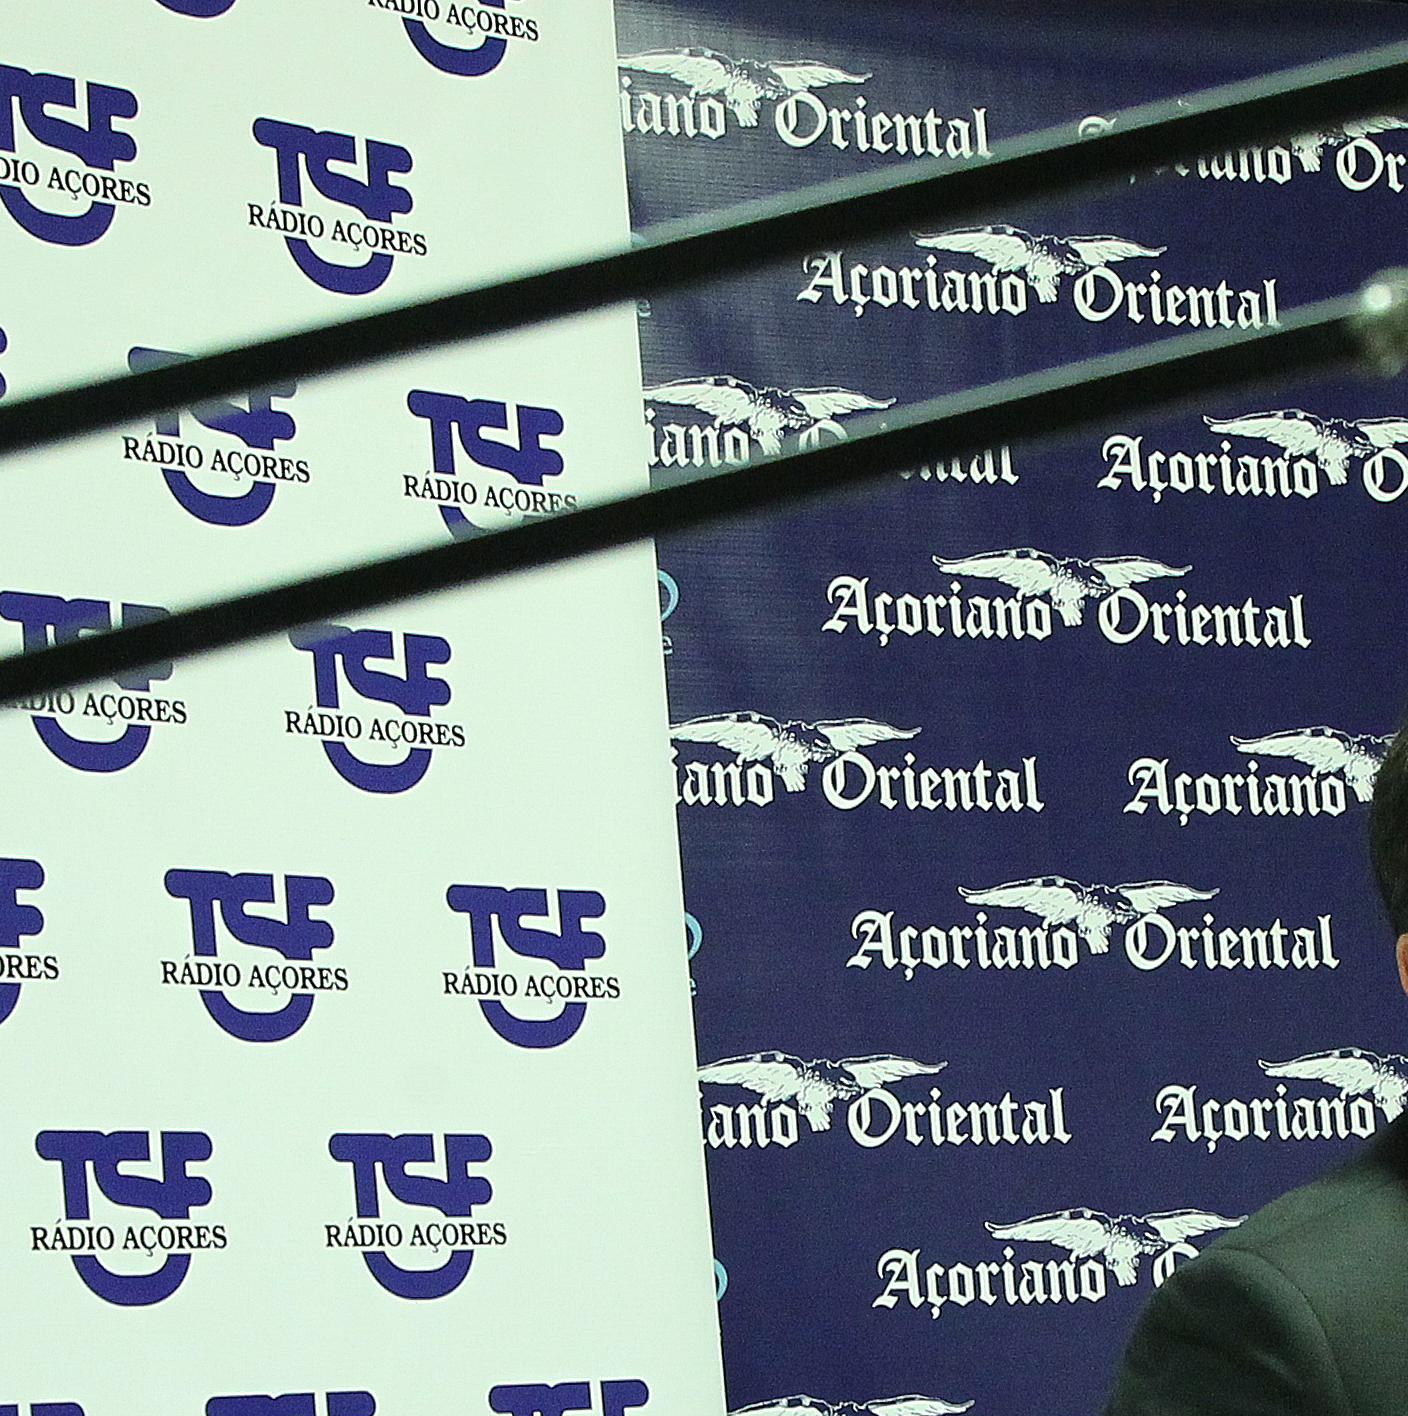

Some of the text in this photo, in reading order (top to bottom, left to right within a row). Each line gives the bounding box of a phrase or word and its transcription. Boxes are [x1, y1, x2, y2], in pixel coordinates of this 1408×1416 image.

[445, 3, 539, 42] AÇORES
[775, 90, 995, 159] Oriental
[47, 167, 152, 207] AÇORES
[247, 202, 428, 257] RÁDIO AÇORES
[796, 250, 1283, 330] Açoriano Oriental
[122, 432, 311, 484] RÁDIO AÇORES
[1096, 434, 1318, 504] Açoriano
[402, 471, 577, 517] RÁDIO AÇORES
[820, 575, 1312, 650] Açoriano Oriental
[82, 693, 188, 726] AÇORES
[284, 708, 466, 749] RÁDIO AÇORES
[821, 752, 1046, 812] Oriental
[1122, 757, 1347, 827] Açoriano
[845, 910, 1341, 981] Açoriano Oriental
[161, 955, 349, 996] RÁDIO AÇORES
[442, 967, 621, 1005] RÁDIO AÇORES
[848, 1088, 1072, 1148] Oriental
[1151, 1084, 1377, 1154] Açoriano
[29, 1220, 228, 1258] RÁDIO AÇORES
[324, 1217, 508, 1254] RÁDIO AÇORES
[872, 1246, 1106, 1320] Açoriano
